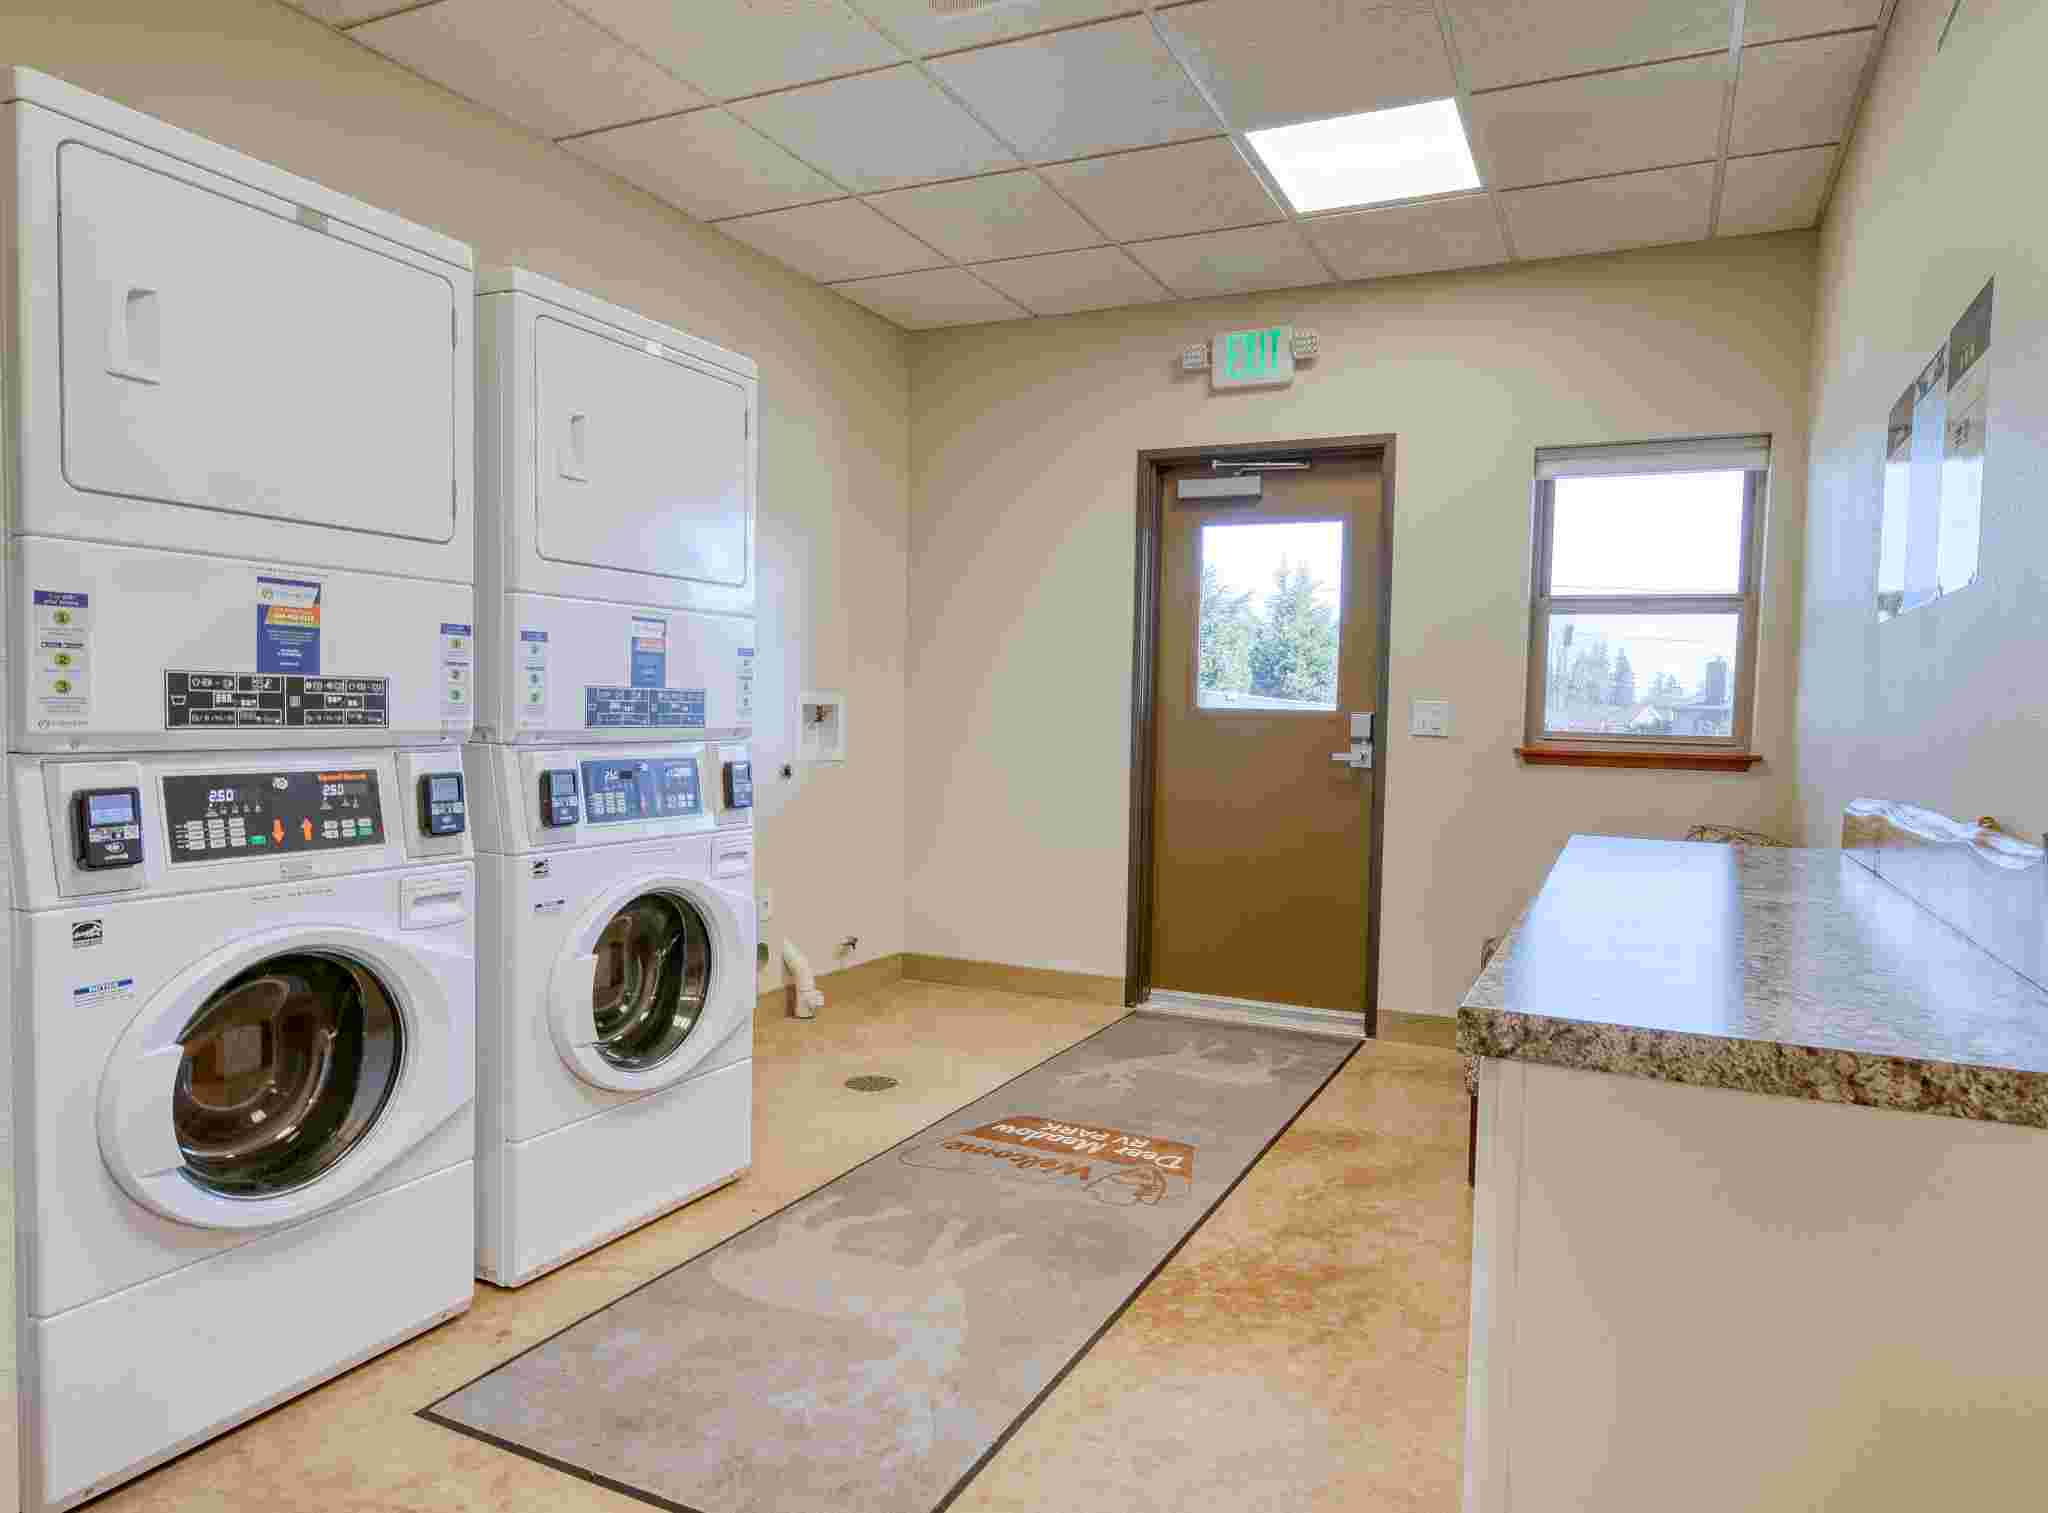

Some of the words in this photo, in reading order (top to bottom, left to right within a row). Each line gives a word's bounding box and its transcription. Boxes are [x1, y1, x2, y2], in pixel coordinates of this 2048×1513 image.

[1226, 328, 1281, 380] EXIT
[991, 1123, 1105, 1154] Meadow
[1042, 1122, 1111, 1141] PARK
[1114, 1146, 1185, 1169] Deer
